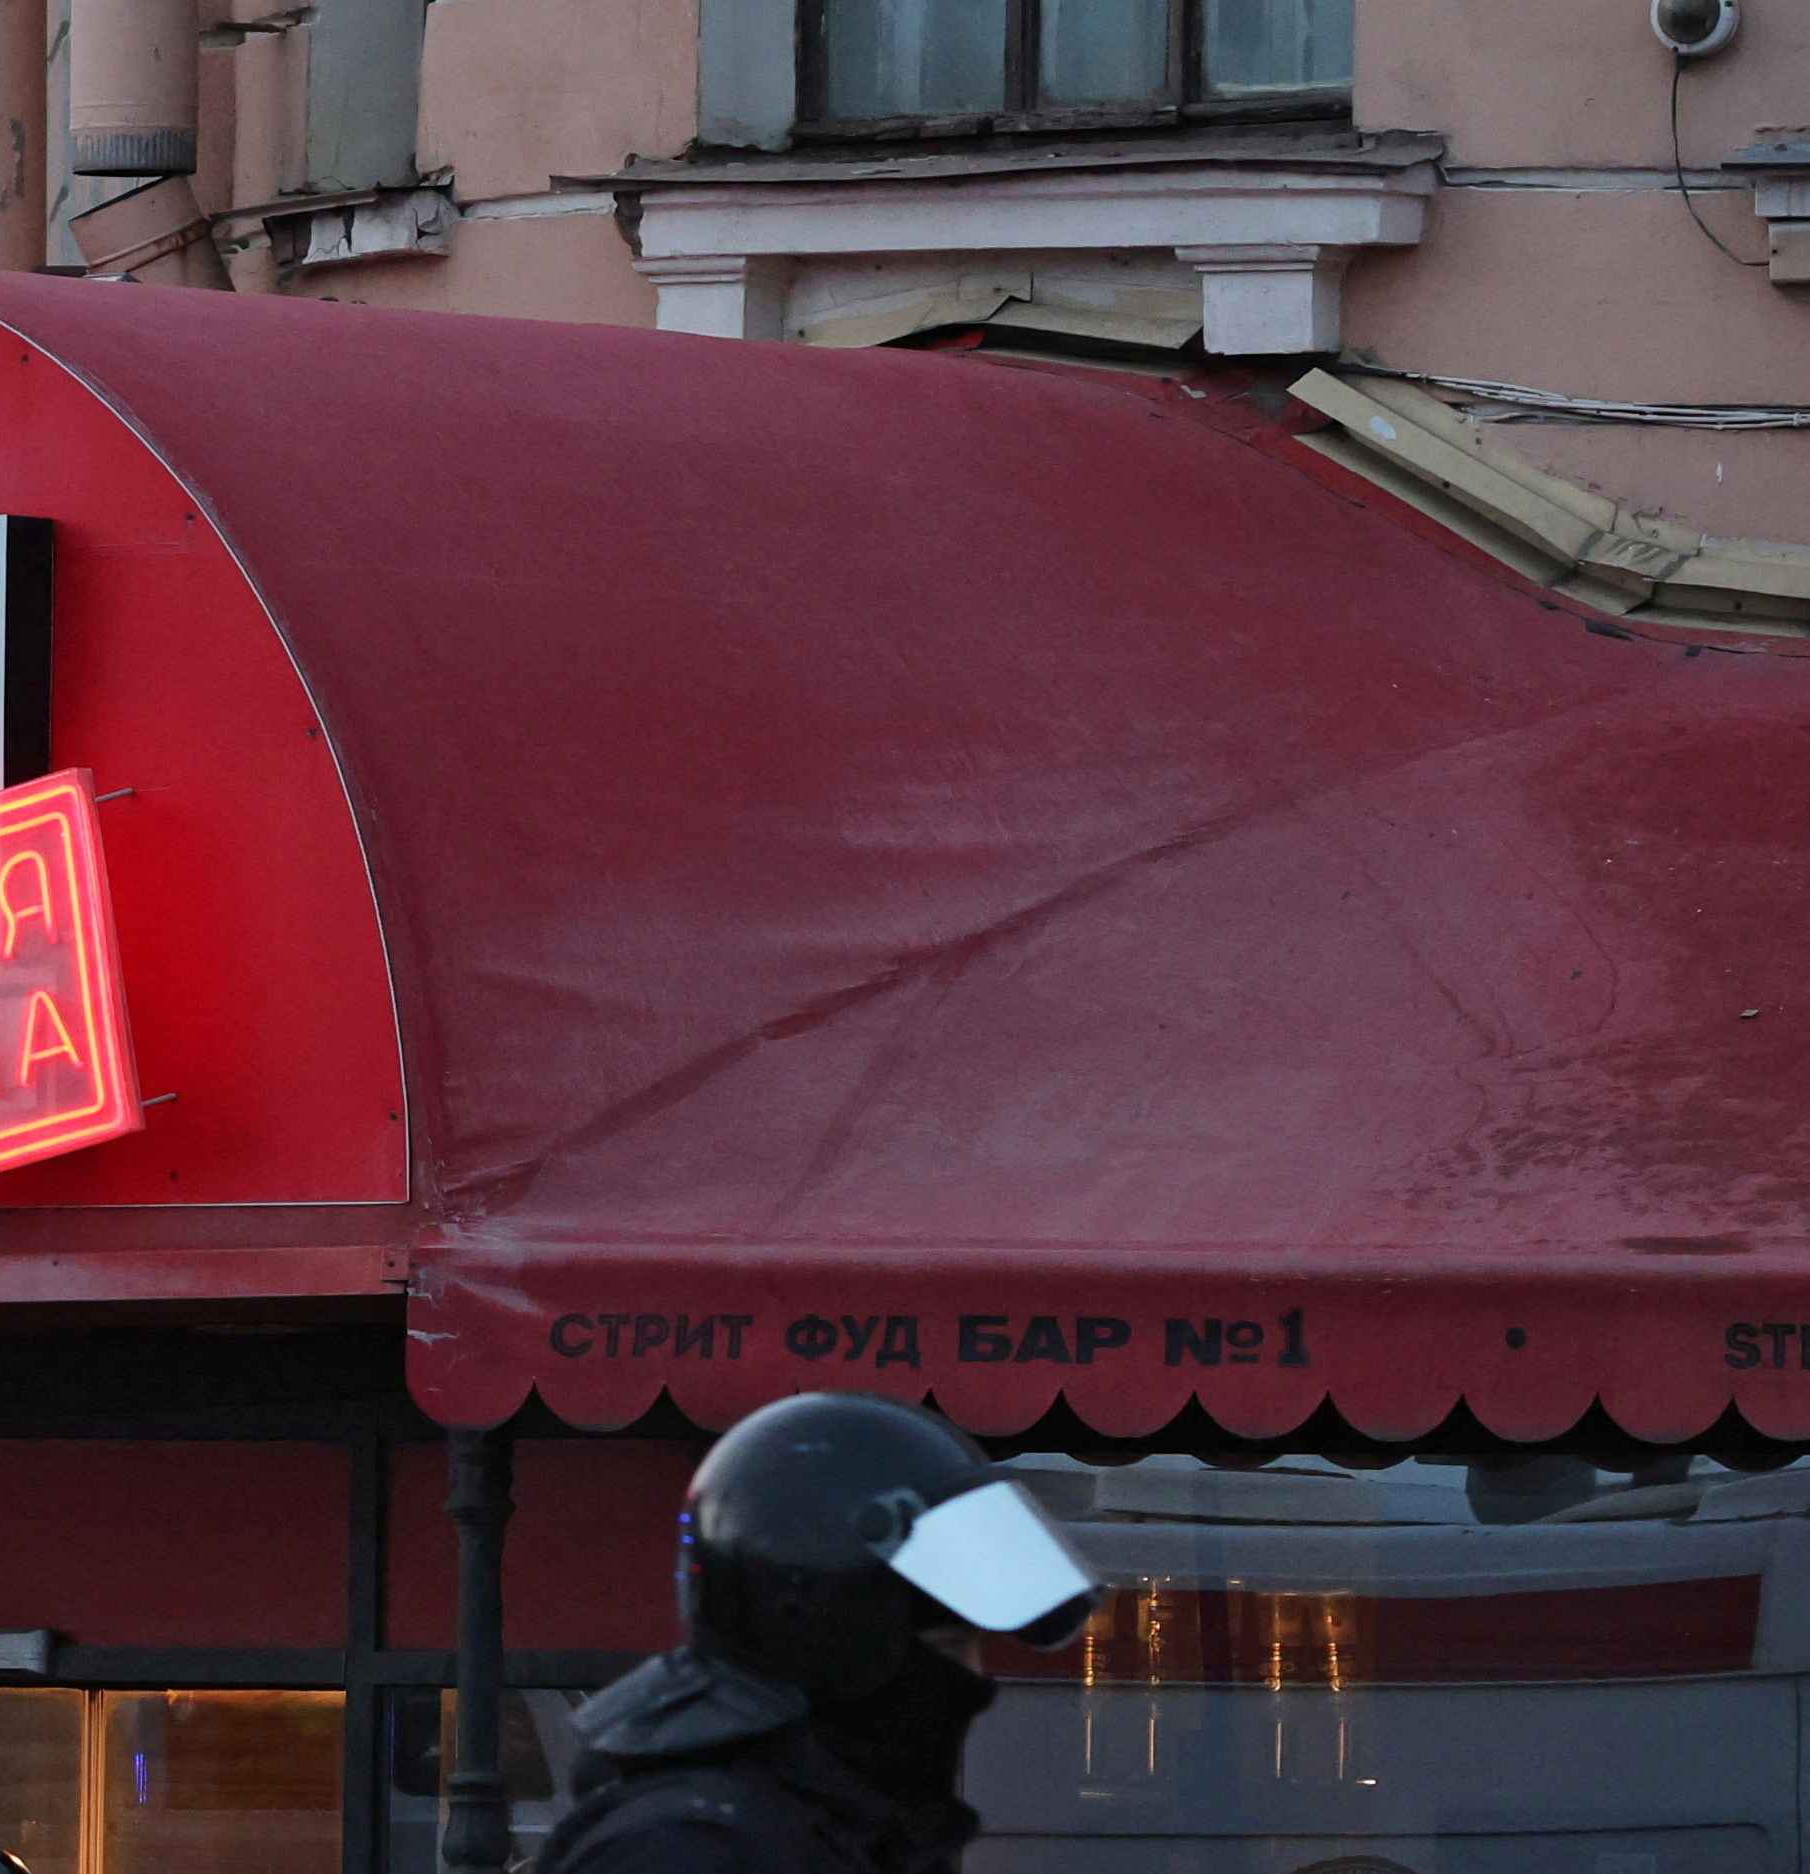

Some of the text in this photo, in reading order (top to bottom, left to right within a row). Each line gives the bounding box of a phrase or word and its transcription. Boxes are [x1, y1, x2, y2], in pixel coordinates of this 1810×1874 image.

[549, 1312, 752, 1360] СТРИТ
[784, 1311, 922, 1369] ФУД
[957, 1315, 1132, 1366] БАР
